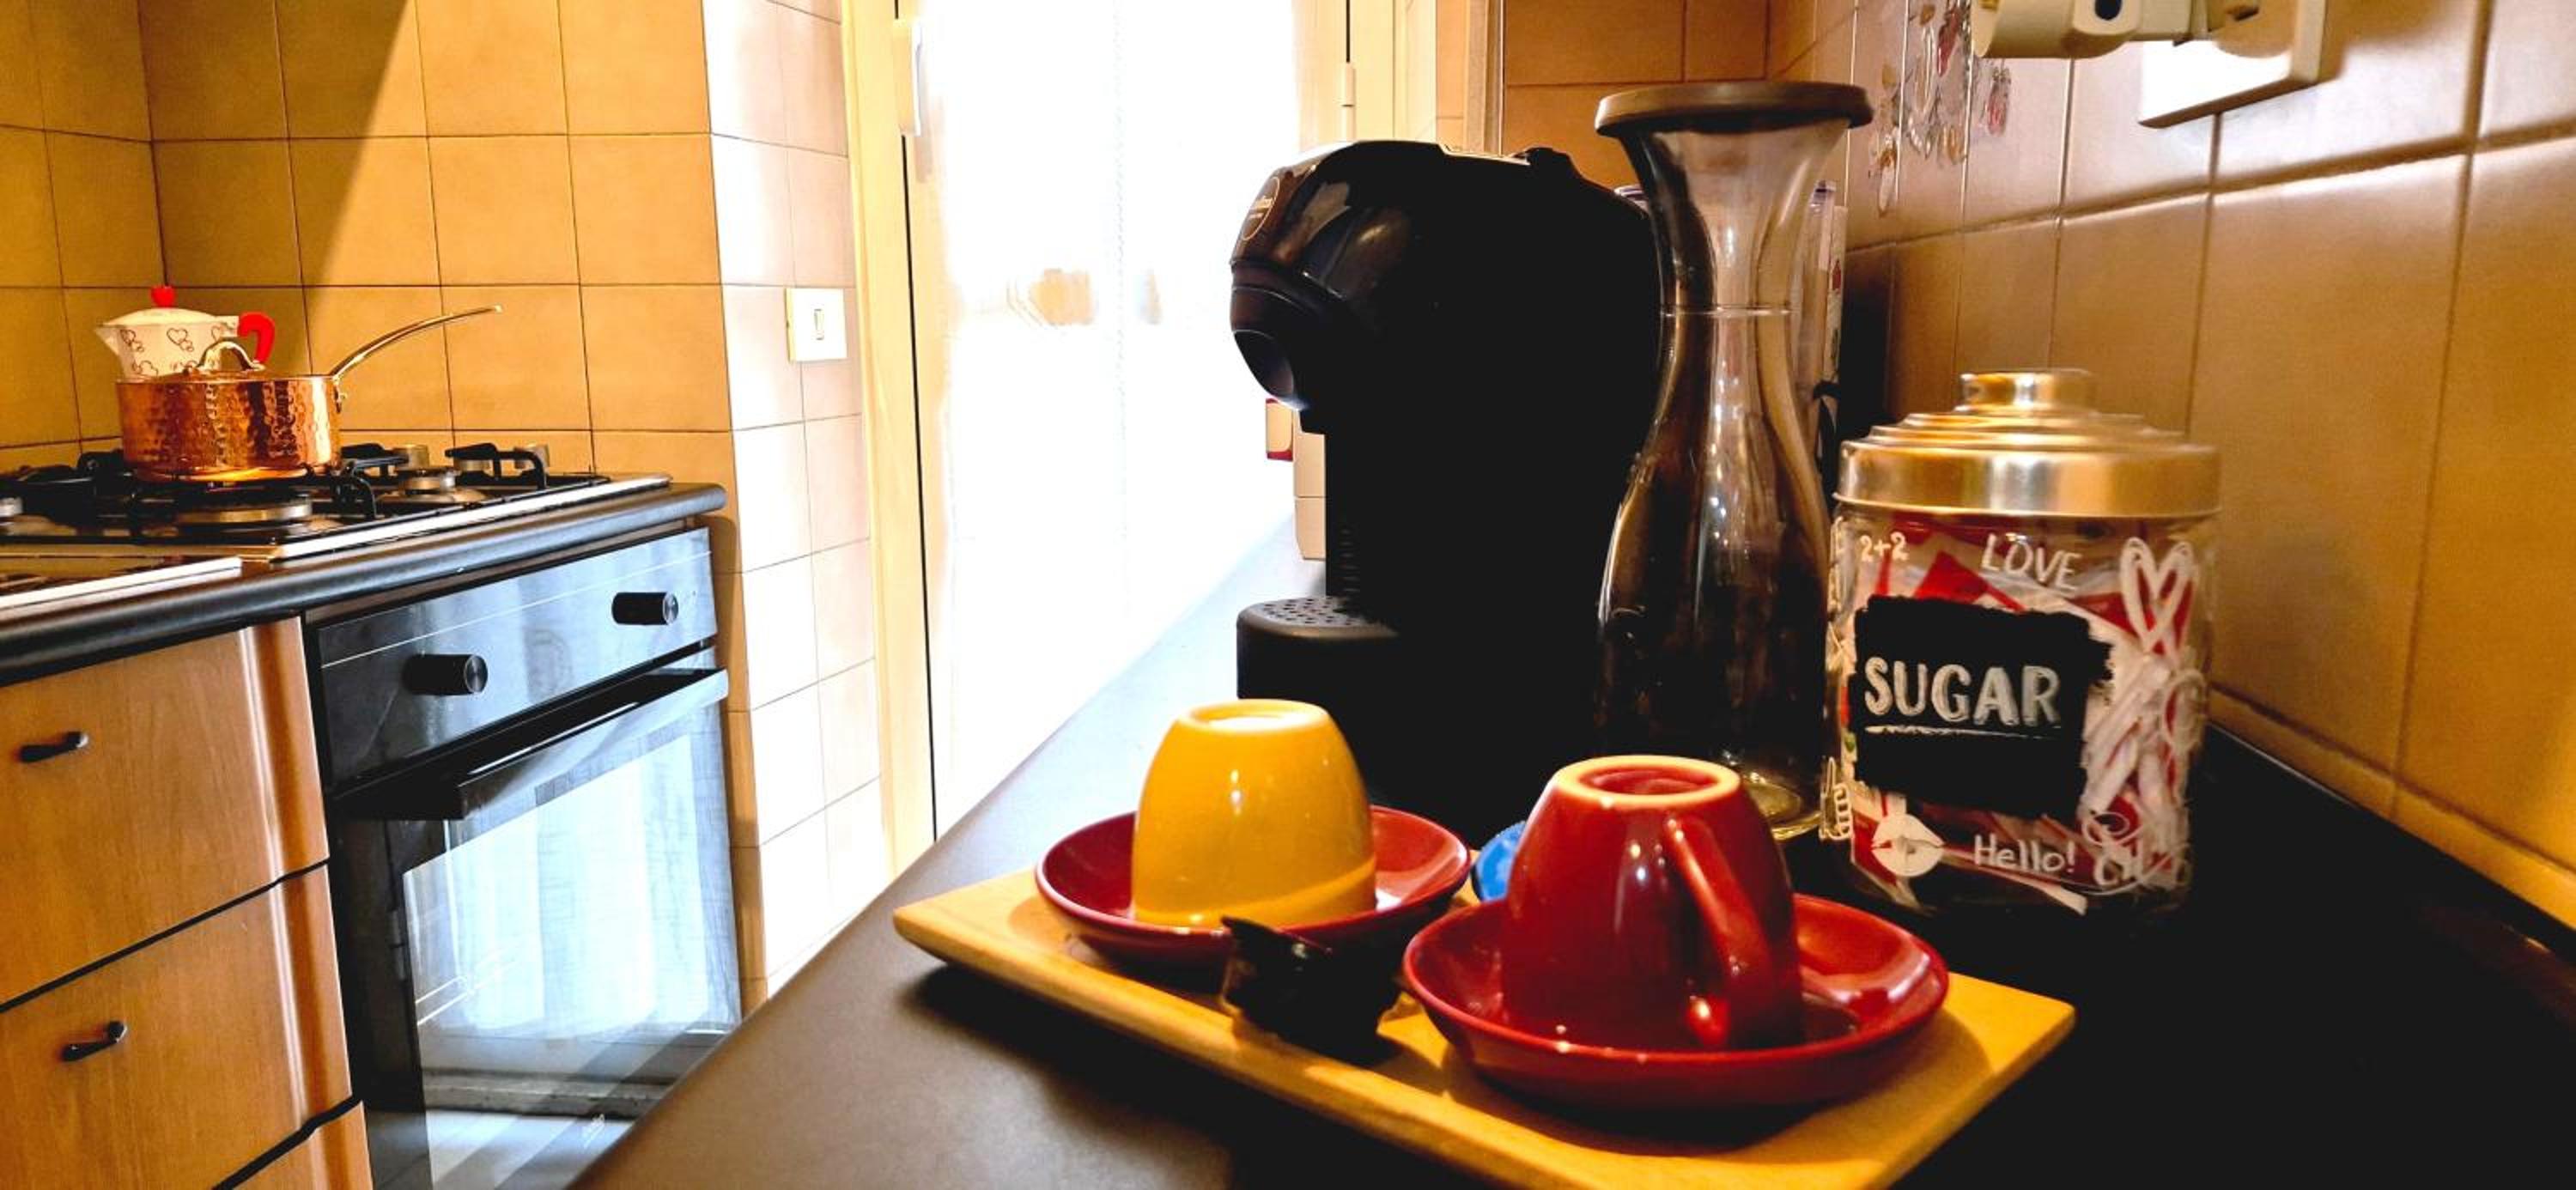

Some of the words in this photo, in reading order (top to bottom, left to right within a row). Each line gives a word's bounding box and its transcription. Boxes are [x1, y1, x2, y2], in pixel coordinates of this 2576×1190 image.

[1859, 531, 1910, 563] 2+2
[1981, 533, 2082, 592] LOVE
[1864, 657, 2061, 727] SUGAR
[1974, 833, 2076, 874] Hello!
